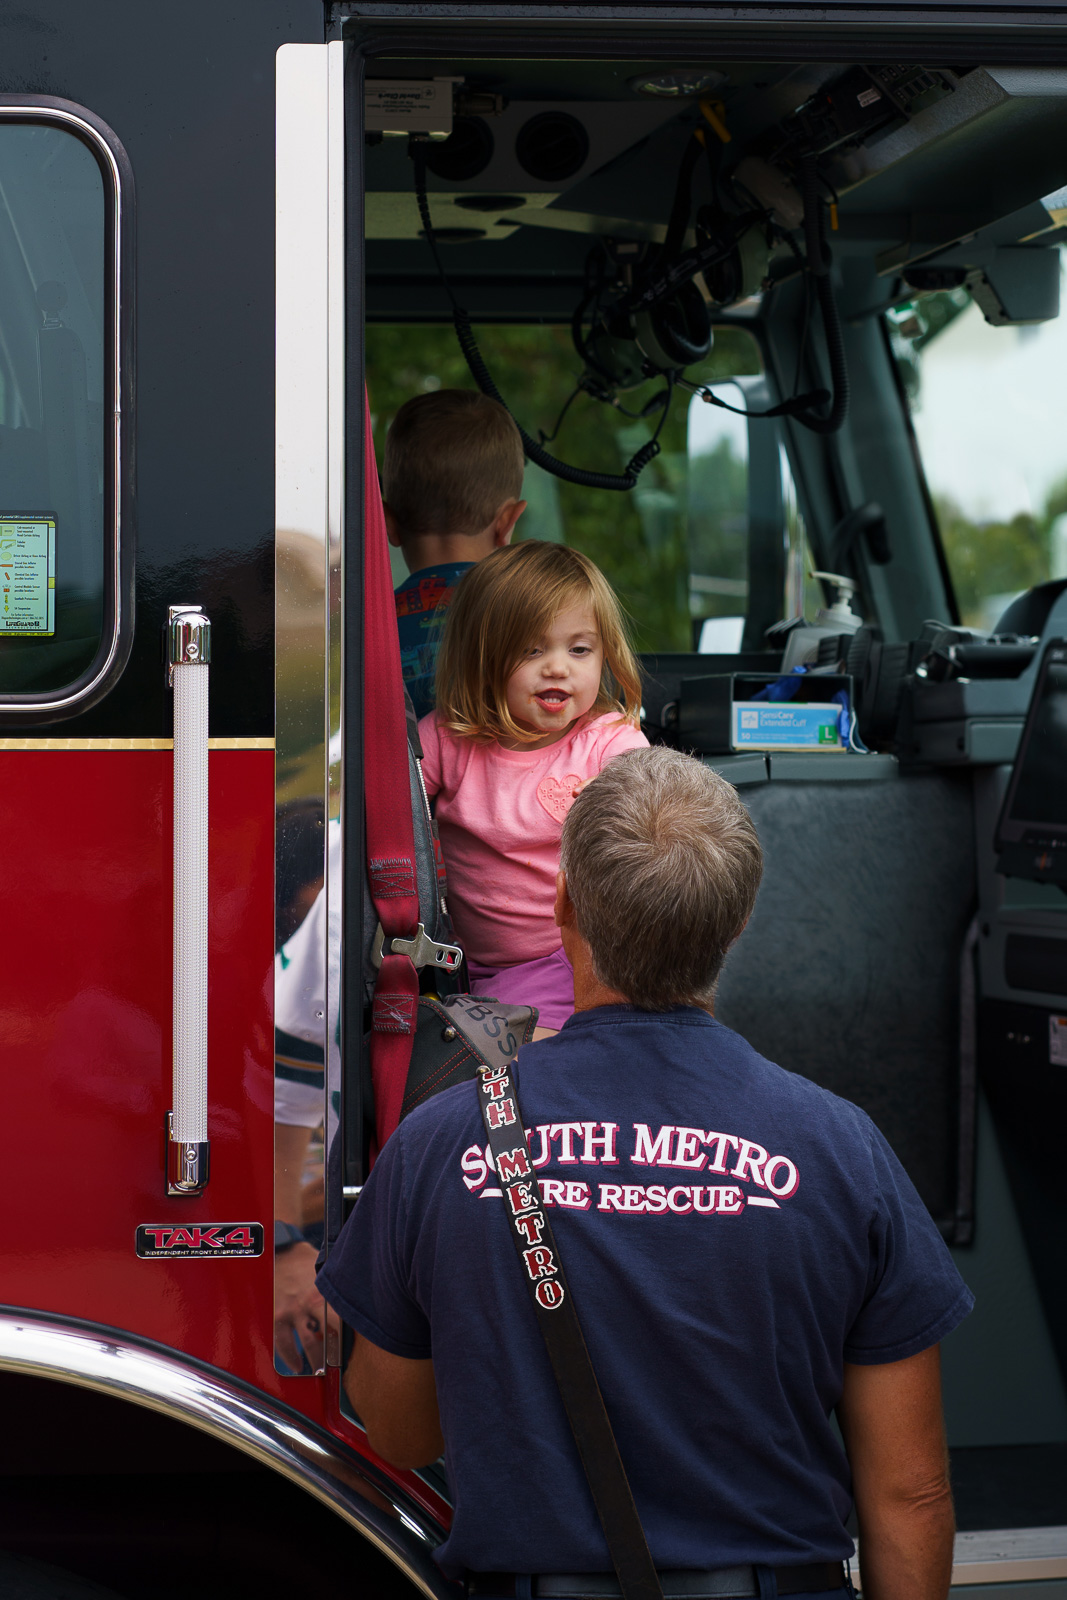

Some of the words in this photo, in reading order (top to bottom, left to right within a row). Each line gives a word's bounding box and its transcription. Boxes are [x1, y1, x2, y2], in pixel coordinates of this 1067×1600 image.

[760, 711, 795, 719] SensiCare
[760, 719, 792, 727] Extended
[792, 719, 807, 727] Cuff
[741, 732, 751, 740] 50
[824, 727, 833, 739] L
[461, 1122, 620, 1193] SUTH
[630, 1123, 800, 1200] METRO
[597, 1183, 745, 1215] RESCUE
[495, 1147, 565, 1310] METRO
[145, 1227, 255, 1248] TAK-4
